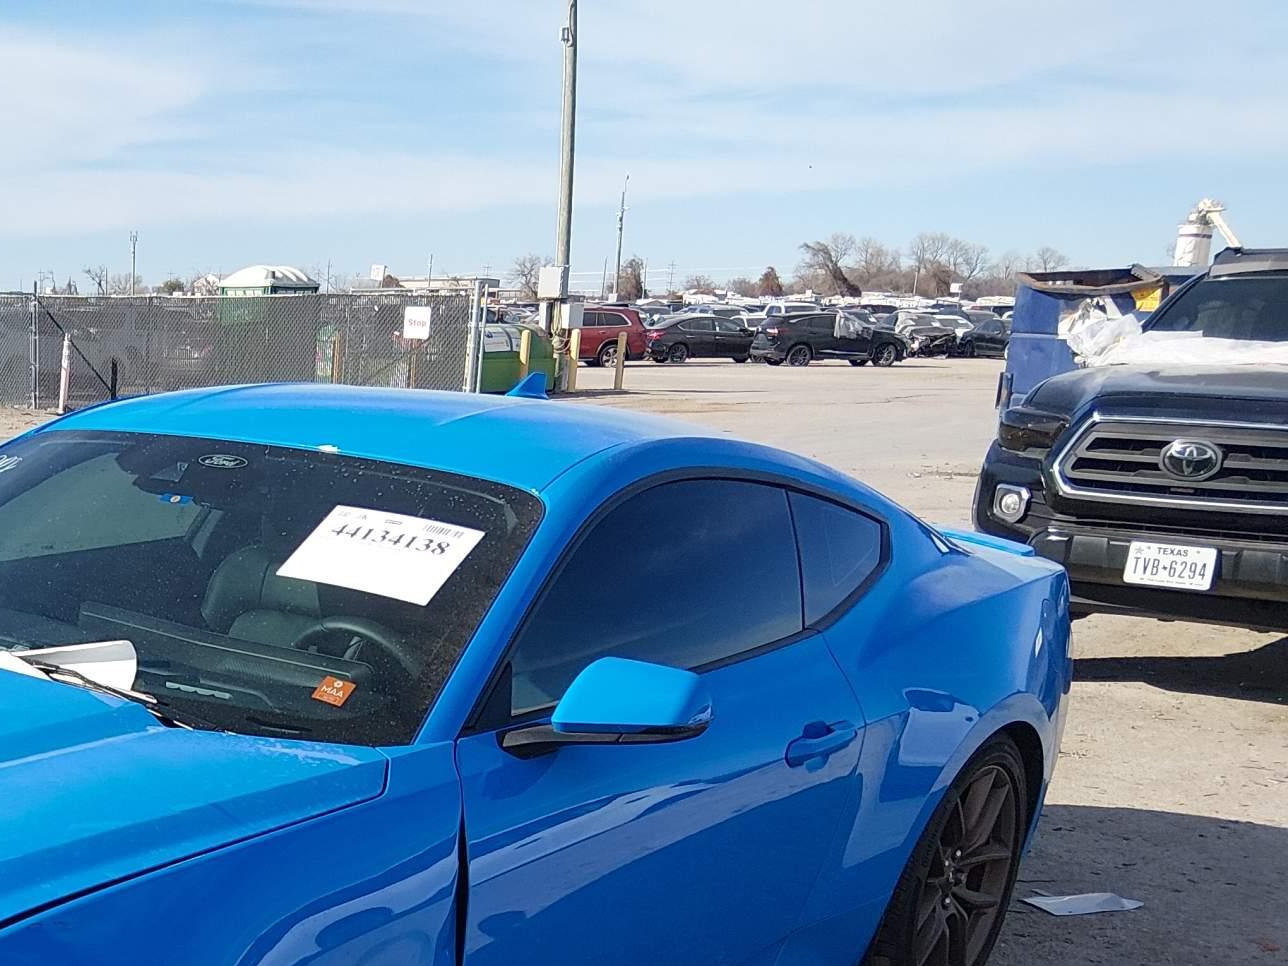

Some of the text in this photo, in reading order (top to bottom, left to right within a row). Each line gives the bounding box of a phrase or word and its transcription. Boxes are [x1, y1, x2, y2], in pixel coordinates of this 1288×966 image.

[408, 318, 427, 329] Stop
[203, 455, 242, 467] Ford
[331, 523, 451, 556] 44134138
[1157, 546, 1189, 557] TEXAS
[321, 685, 344, 698] MAA
